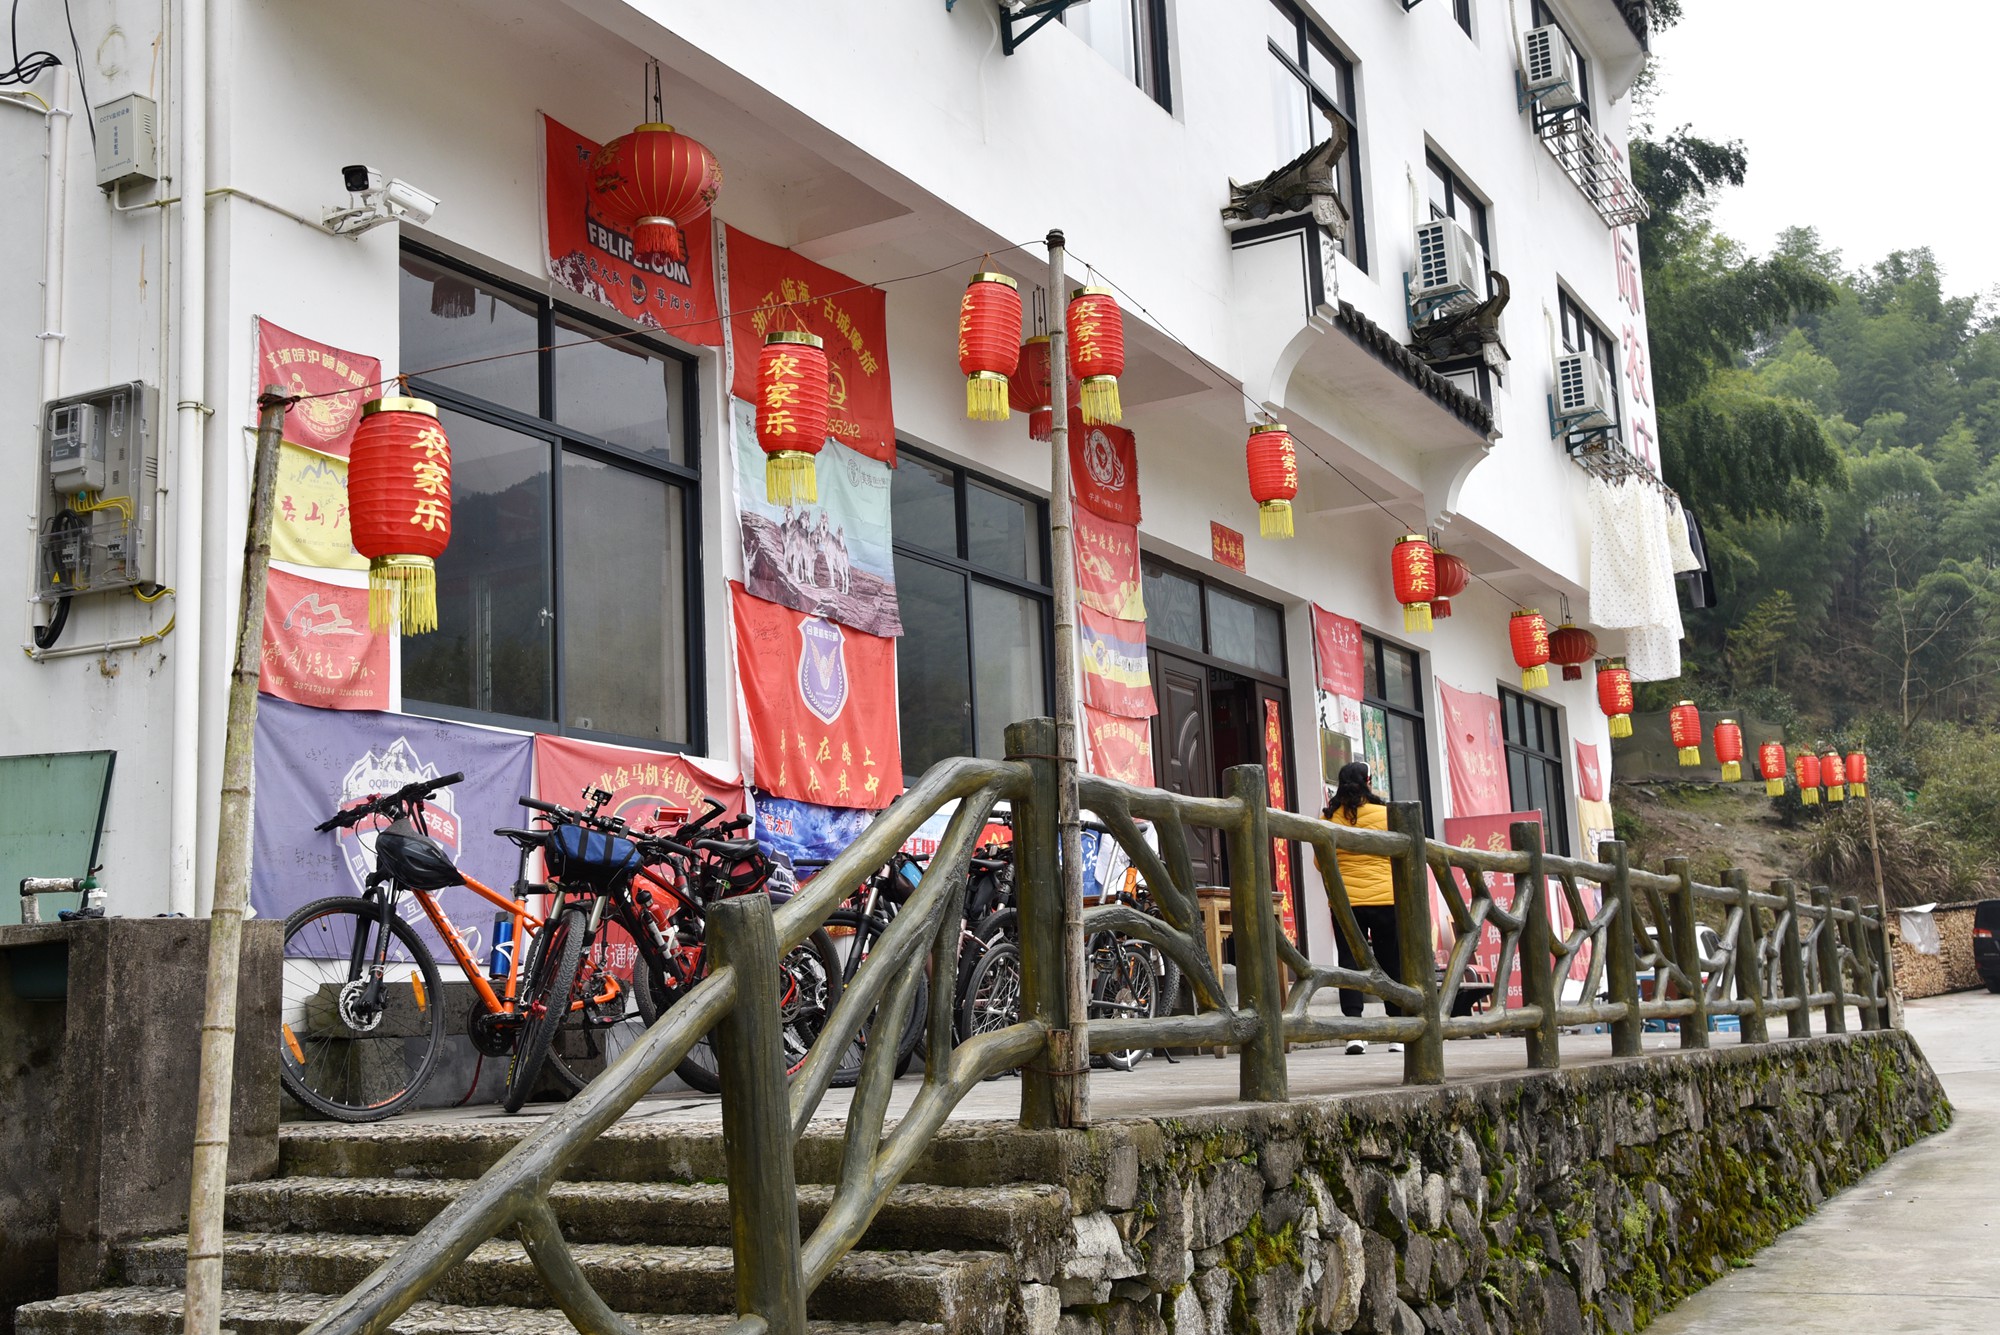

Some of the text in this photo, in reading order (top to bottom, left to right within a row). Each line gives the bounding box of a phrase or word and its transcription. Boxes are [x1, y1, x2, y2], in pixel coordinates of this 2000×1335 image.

[655, 287, 697, 320] 阜阳中
[1072, 301, 1103, 363] 农家乐
[765, 353, 805, 436] 农家乐
[409, 426, 451, 532] 农家乐
[1279, 437, 1298, 489] 农家乐
[281, 495, 348, 529] 吾山户
[1406, 547, 1430, 592] 农家乐
[1529, 617, 1549, 656] 农家乐
[1614, 673, 1632, 707] 农家乐
[1763, 746, 1779, 774] 农家乐
